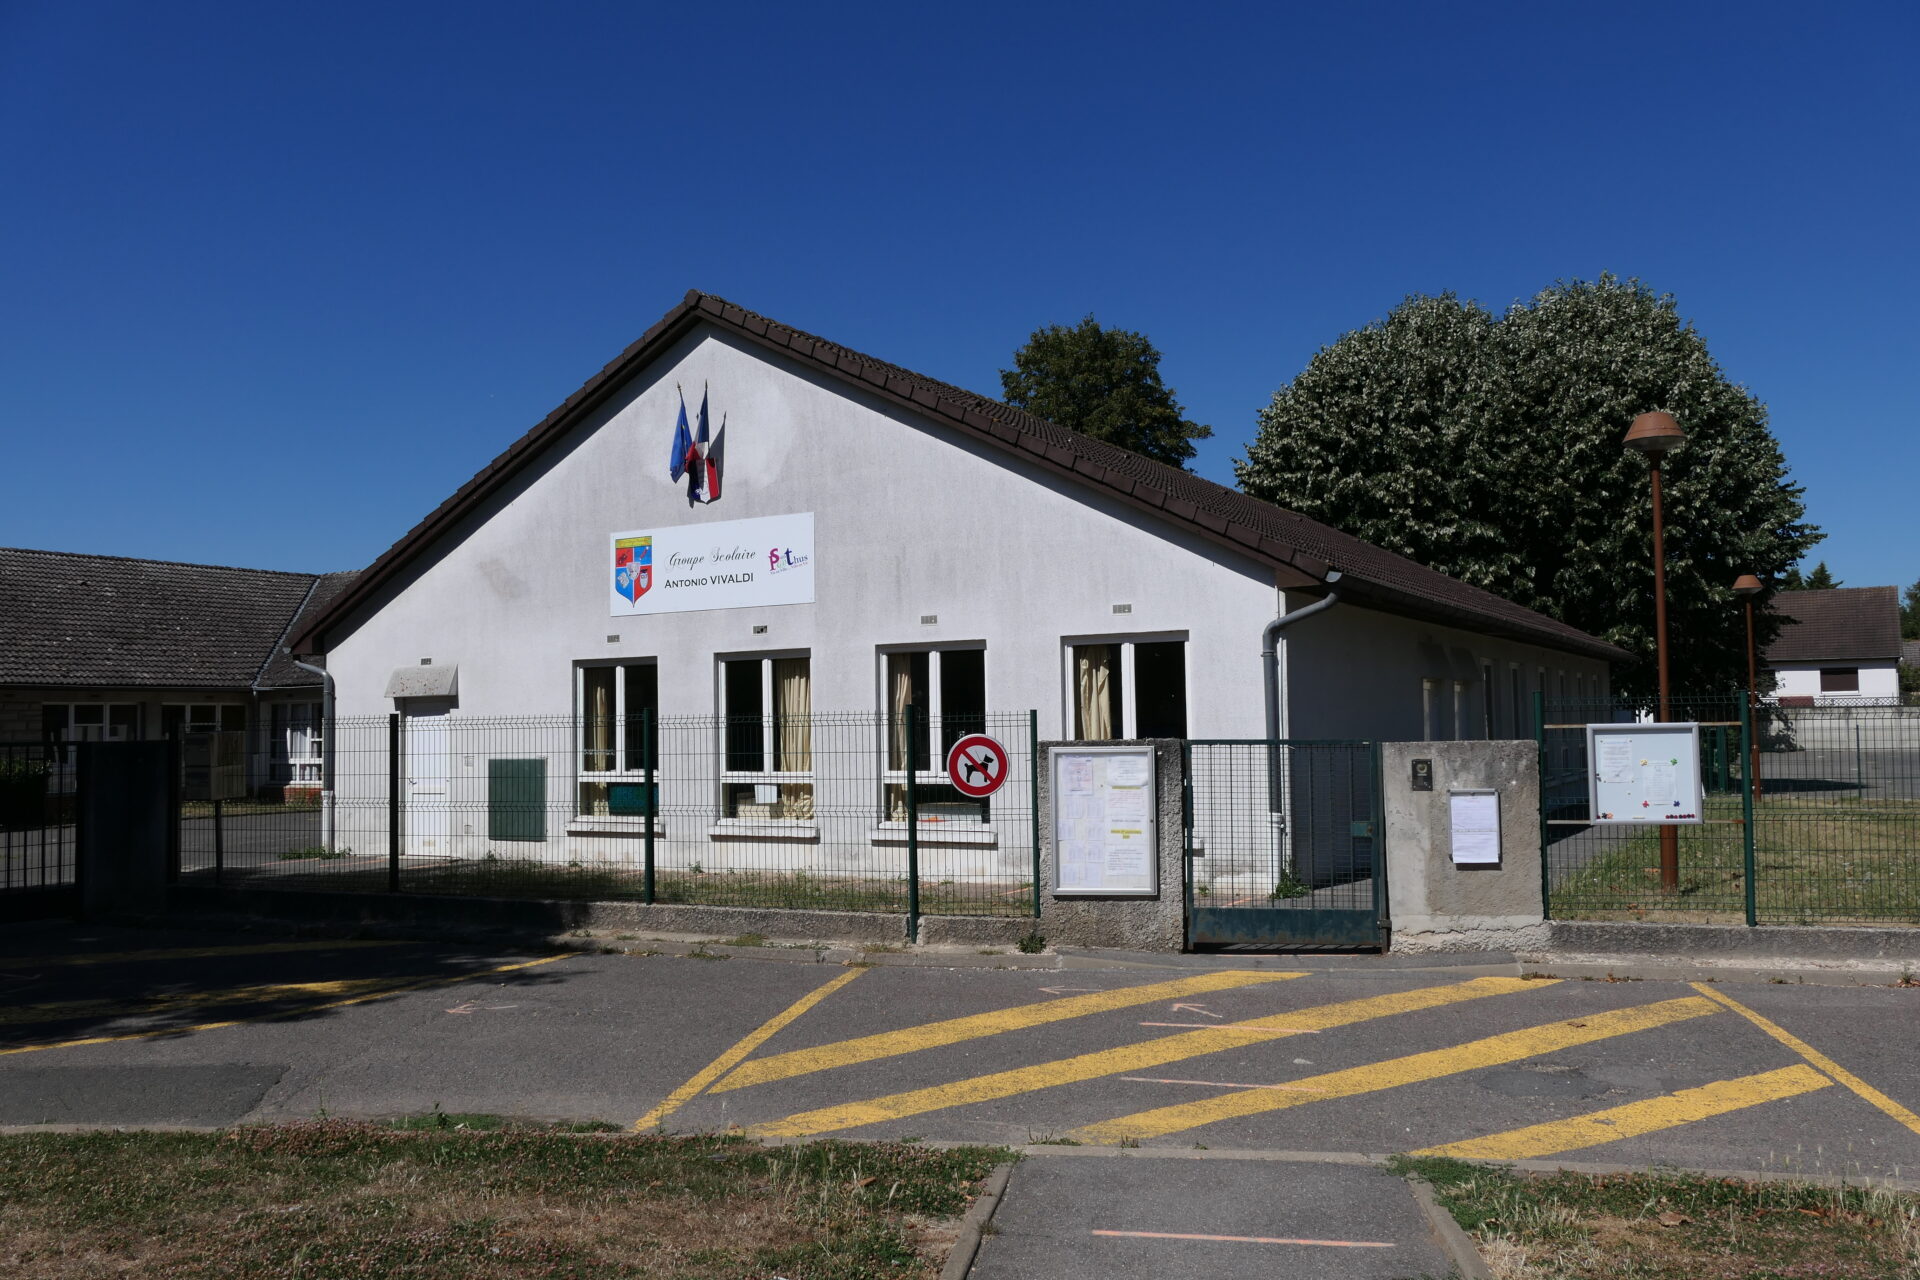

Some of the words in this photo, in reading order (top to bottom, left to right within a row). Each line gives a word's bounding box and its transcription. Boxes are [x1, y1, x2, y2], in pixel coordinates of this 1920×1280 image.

[665, 551, 705, 571] Groupe
[711, 545, 756, 565] Scolaire
[664, 577, 708, 588] ANTONIO
[710, 572, 754, 585] VIVALDI
